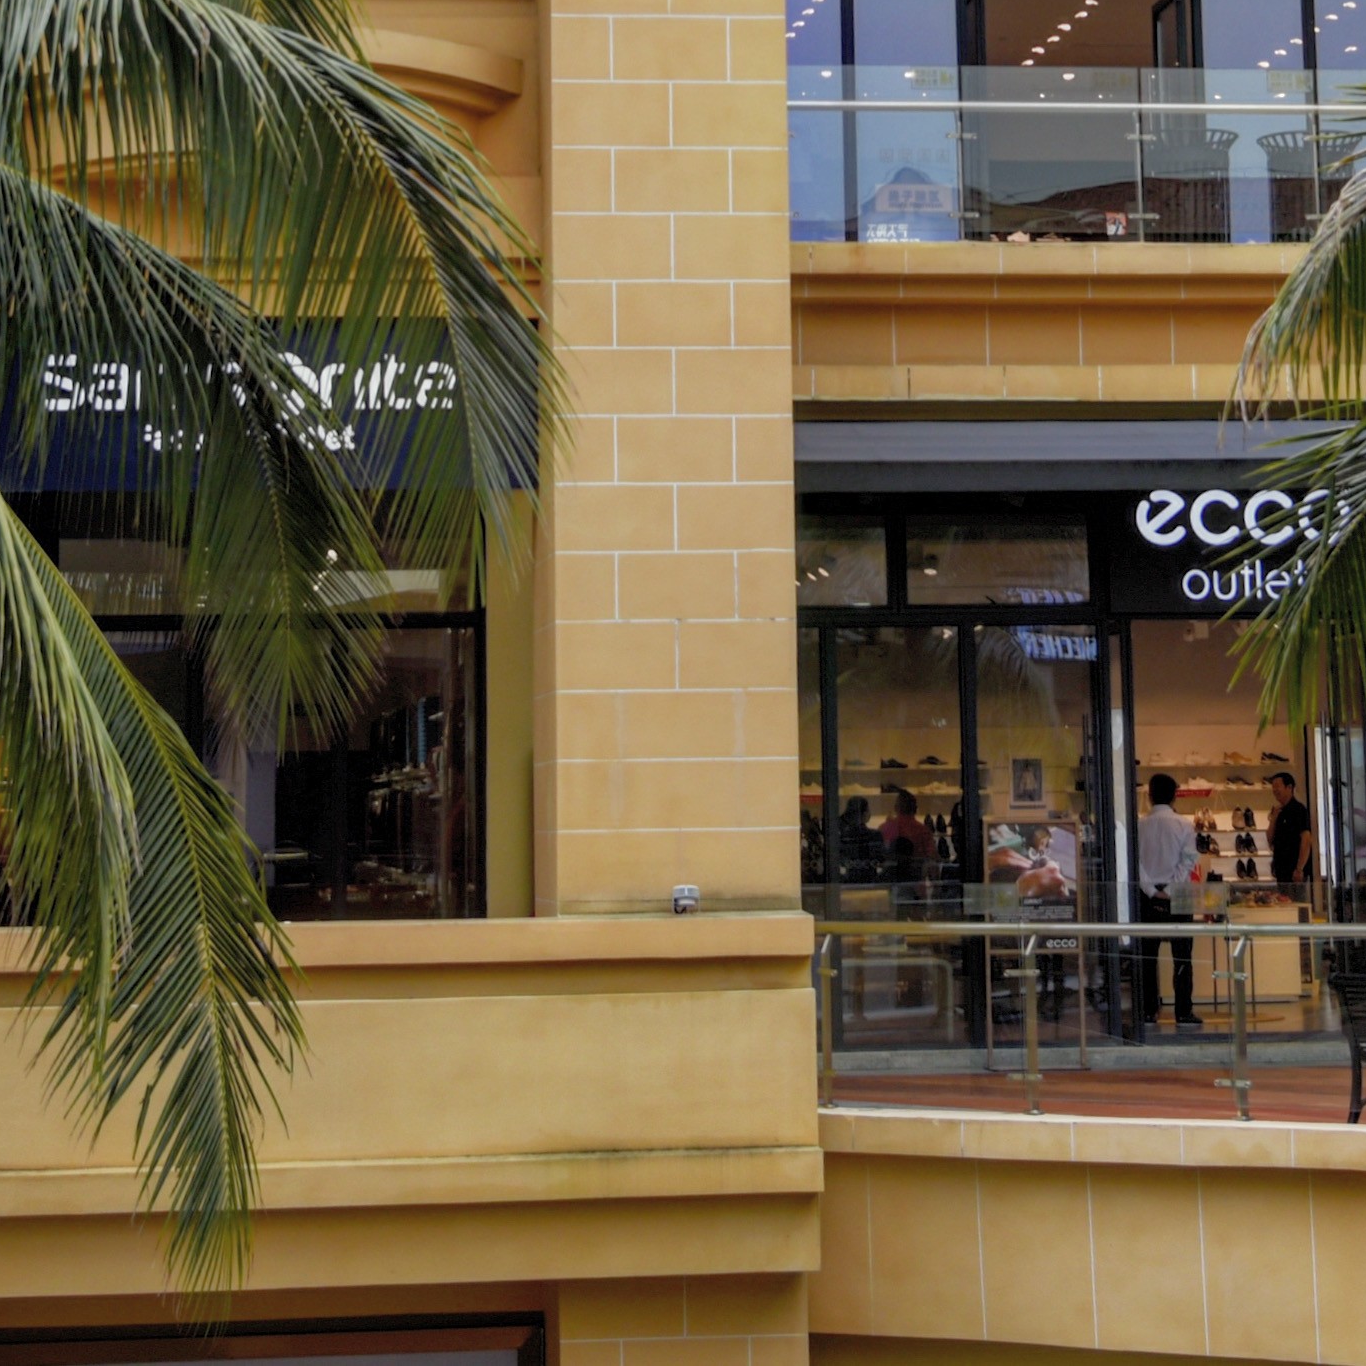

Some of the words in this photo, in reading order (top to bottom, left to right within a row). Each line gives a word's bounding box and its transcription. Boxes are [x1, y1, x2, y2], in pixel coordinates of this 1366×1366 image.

[44, 351, 456, 412] Saonite
[1136, 488, 1351, 546] ecco
[1182, 558, 1307, 600] outlet
[1045, 938, 1077, 948] ecco
